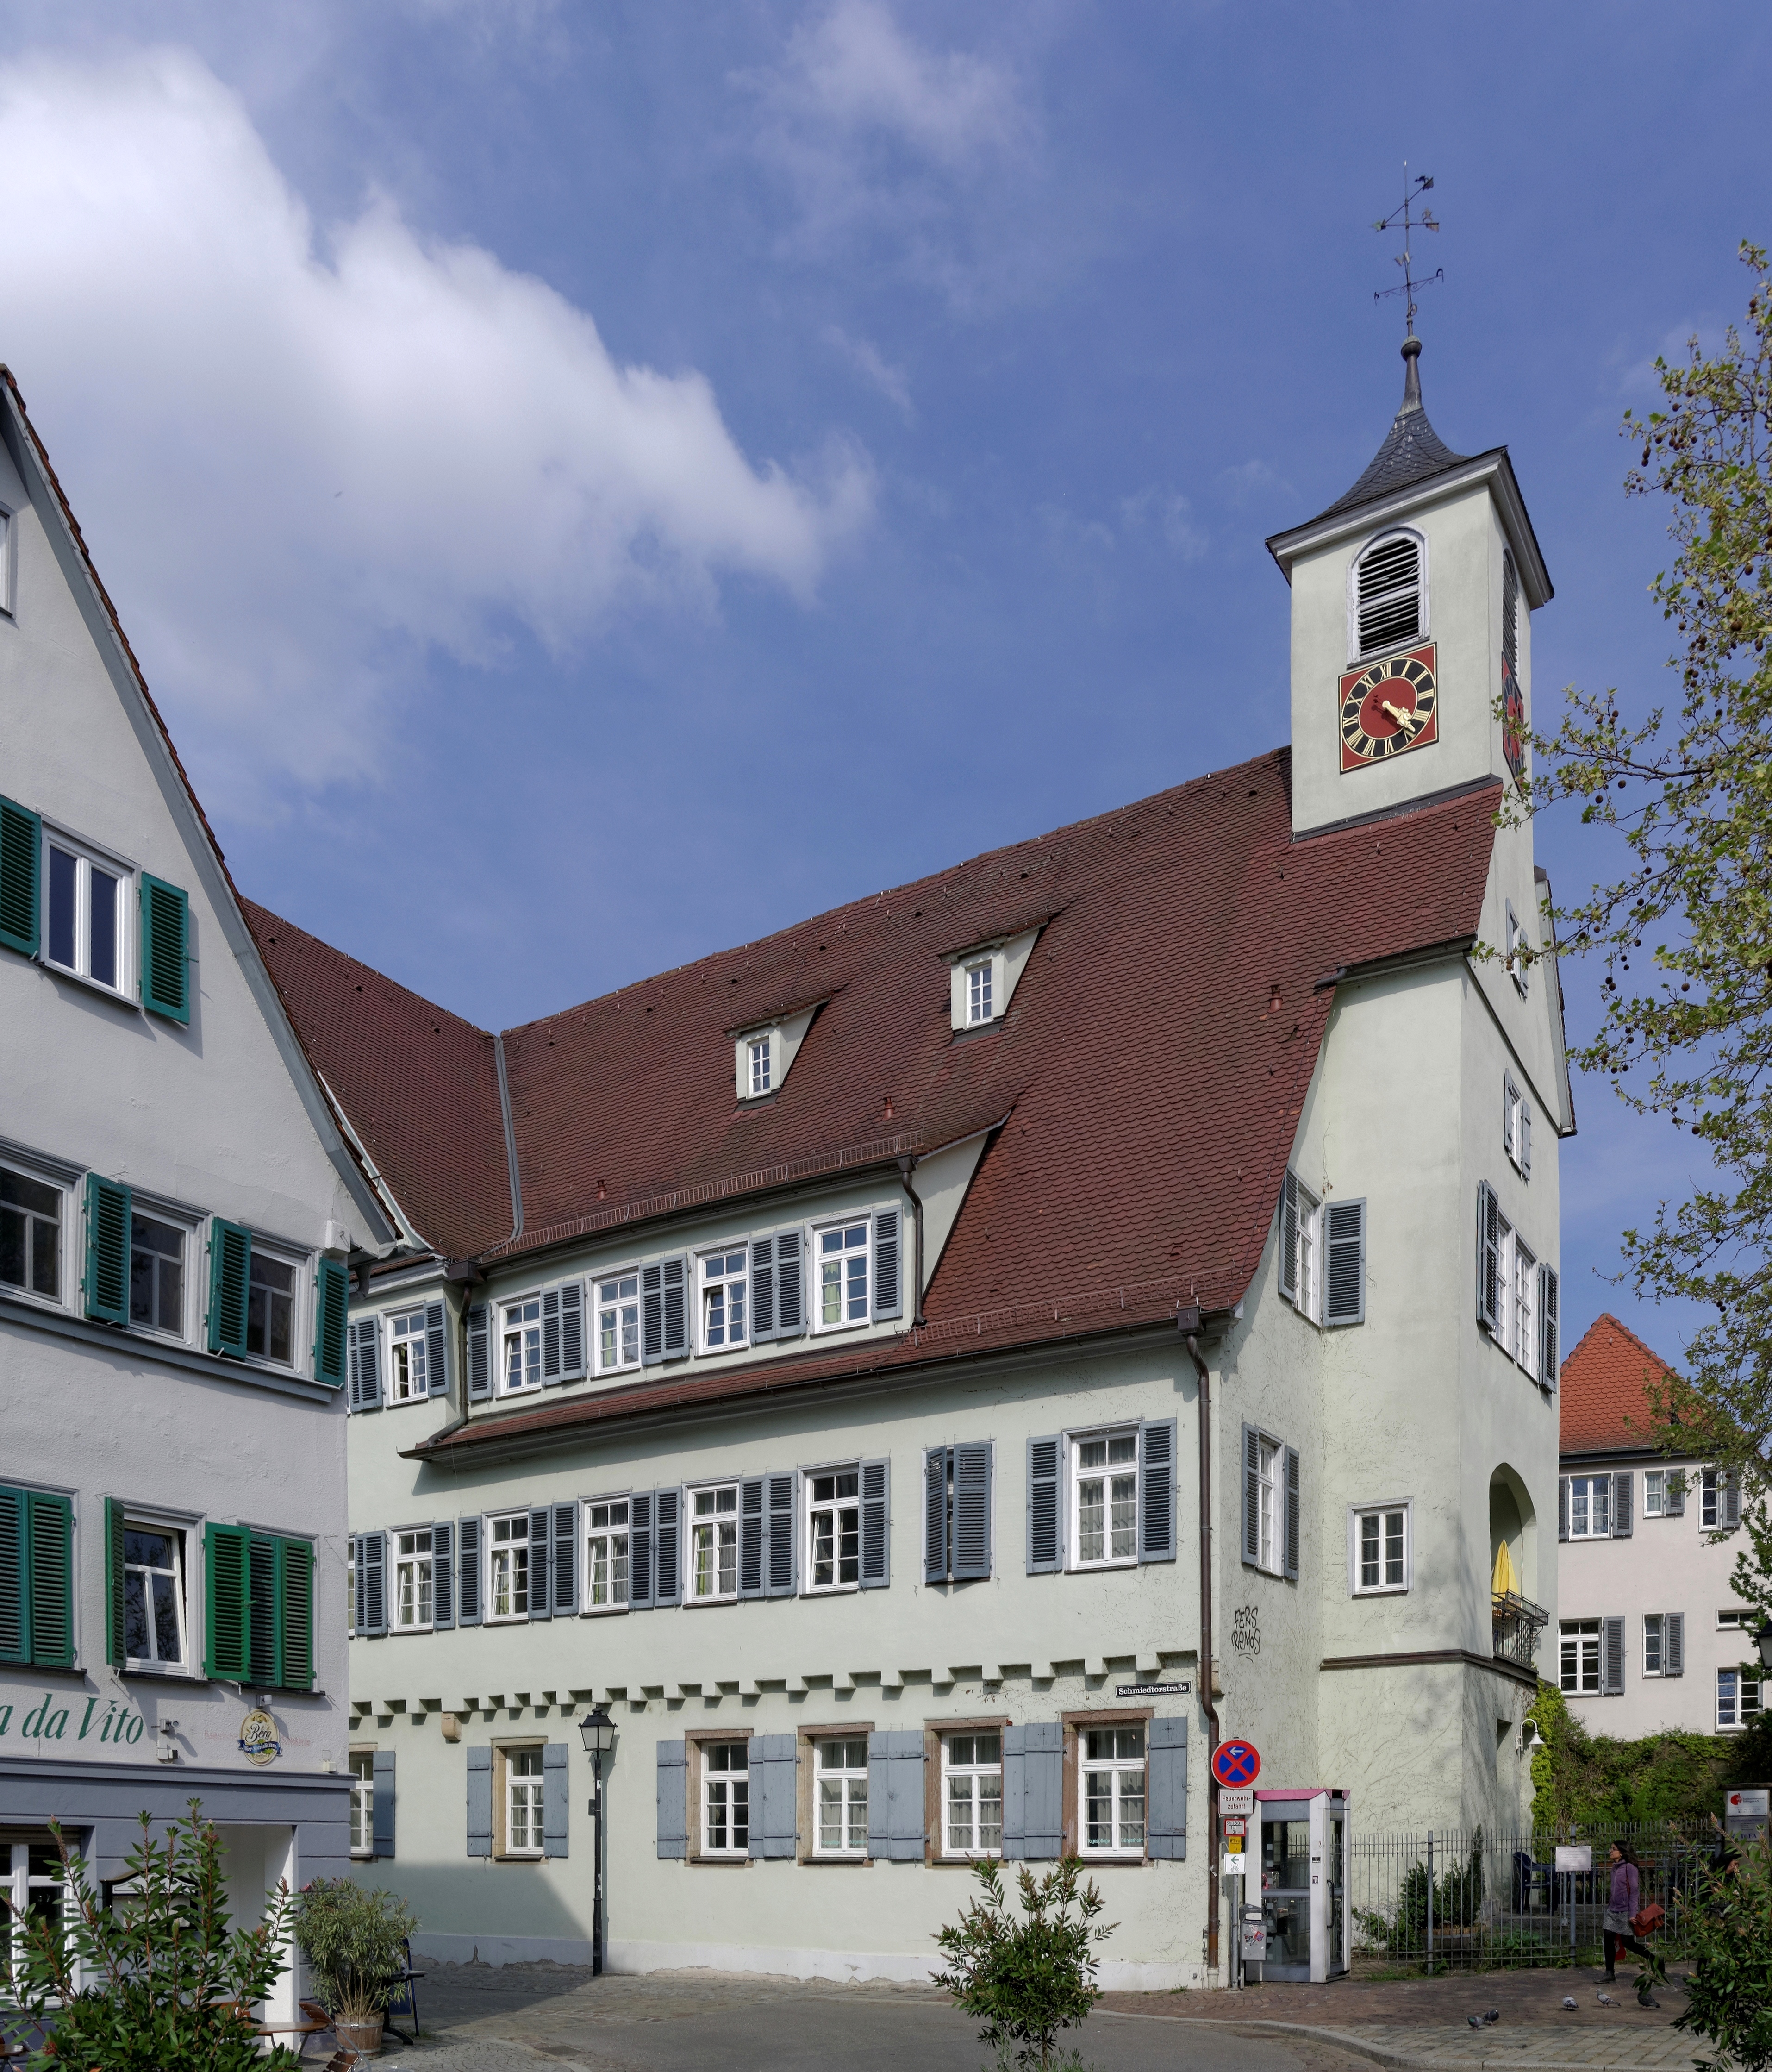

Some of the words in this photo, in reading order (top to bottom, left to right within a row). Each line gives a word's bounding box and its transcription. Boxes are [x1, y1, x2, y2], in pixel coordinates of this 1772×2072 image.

[1400, 660, 1412, 676] I
[1413, 669, 1429, 685] II
[1346, 695, 1364, 707] X
[1418, 687, 1434, 701] III
[1118, 1684, 1187, 1695] Schmiedtorstraße
[22, 1693, 69, 1739] da
[78, 1697, 144, 1744] Vito
[245, 1723, 272, 1743] Berg
